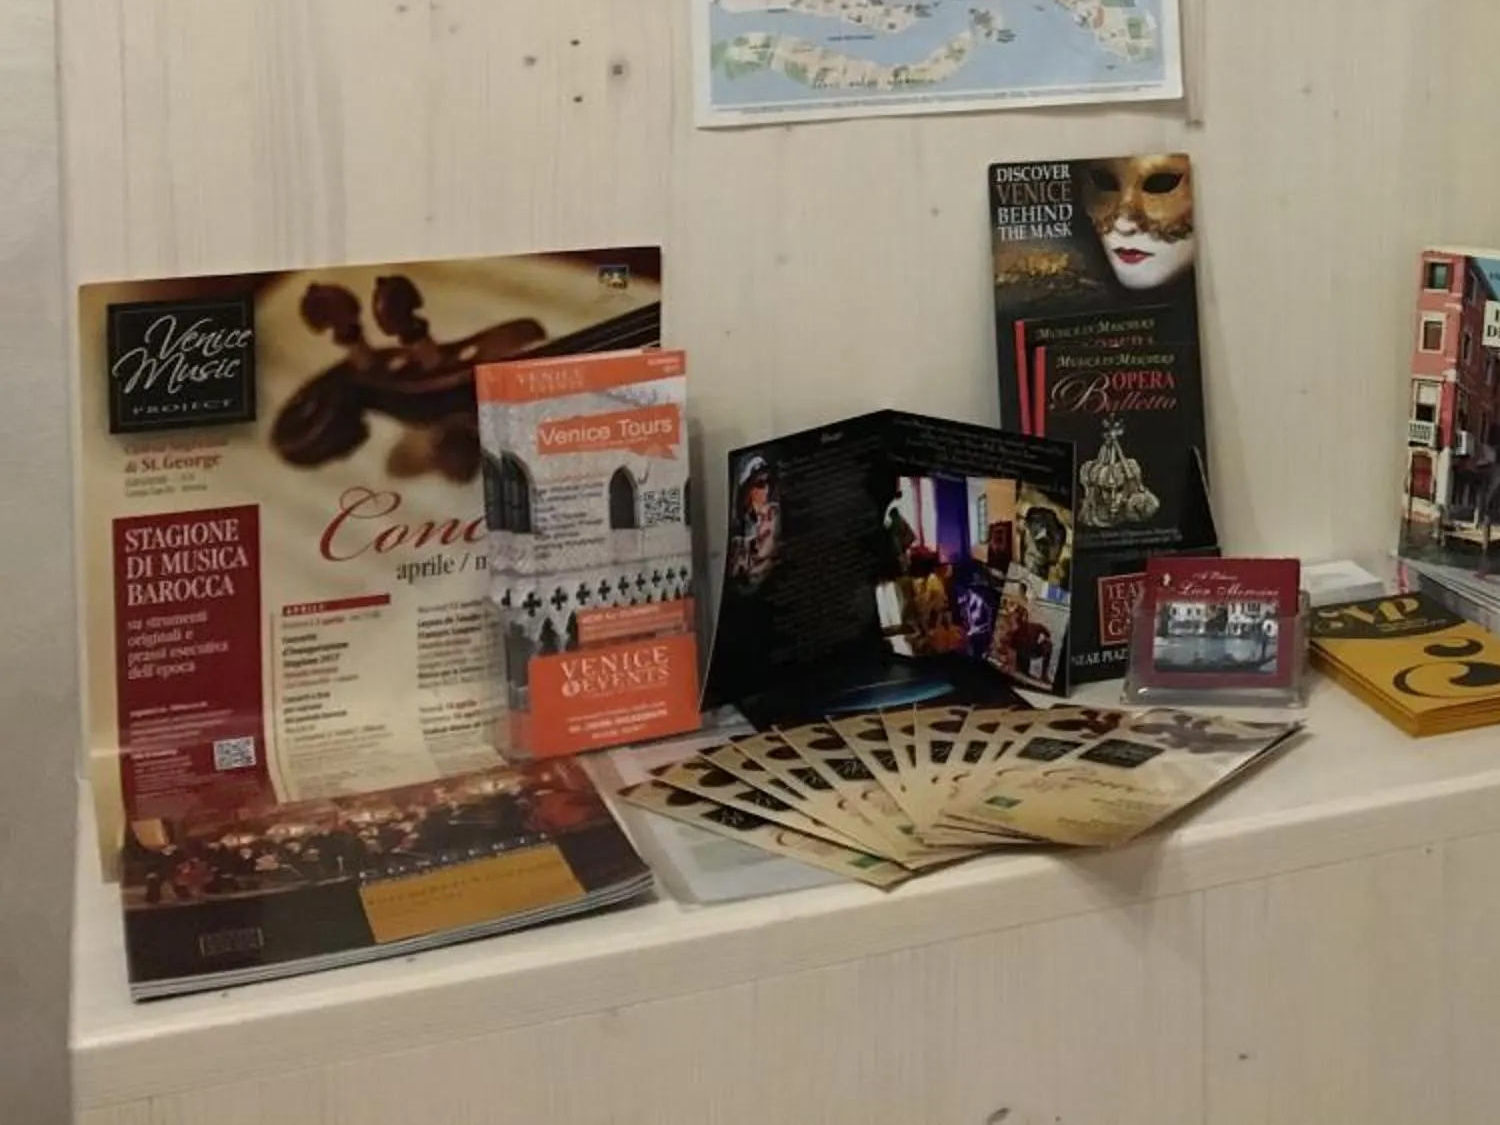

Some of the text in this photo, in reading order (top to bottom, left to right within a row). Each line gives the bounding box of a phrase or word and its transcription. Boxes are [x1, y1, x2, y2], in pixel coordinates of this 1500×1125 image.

[995, 163, 1071, 183] DISCOVER
[997, 181, 1072, 205] VENICE
[998, 204, 1073, 225] BEHIND
[1000, 223, 1073, 241] THE MASK
[144, 314, 251, 359] Venice
[112, 347, 242, 395] Music
[1112, 370, 1176, 390] OPERA
[539, 418, 673, 446] Venice Tours
[162, 454, 223, 471] George
[125, 518, 240, 553] STAGIONE
[319, 486, 488, 562] Conc
[127, 546, 249, 581] DI MUSICA
[396, 553, 455, 584] aprile
[127, 574, 236, 606] BAROCCA
[560, 645, 670, 680] VENICE
[581, 667, 672, 692] EVENTS
